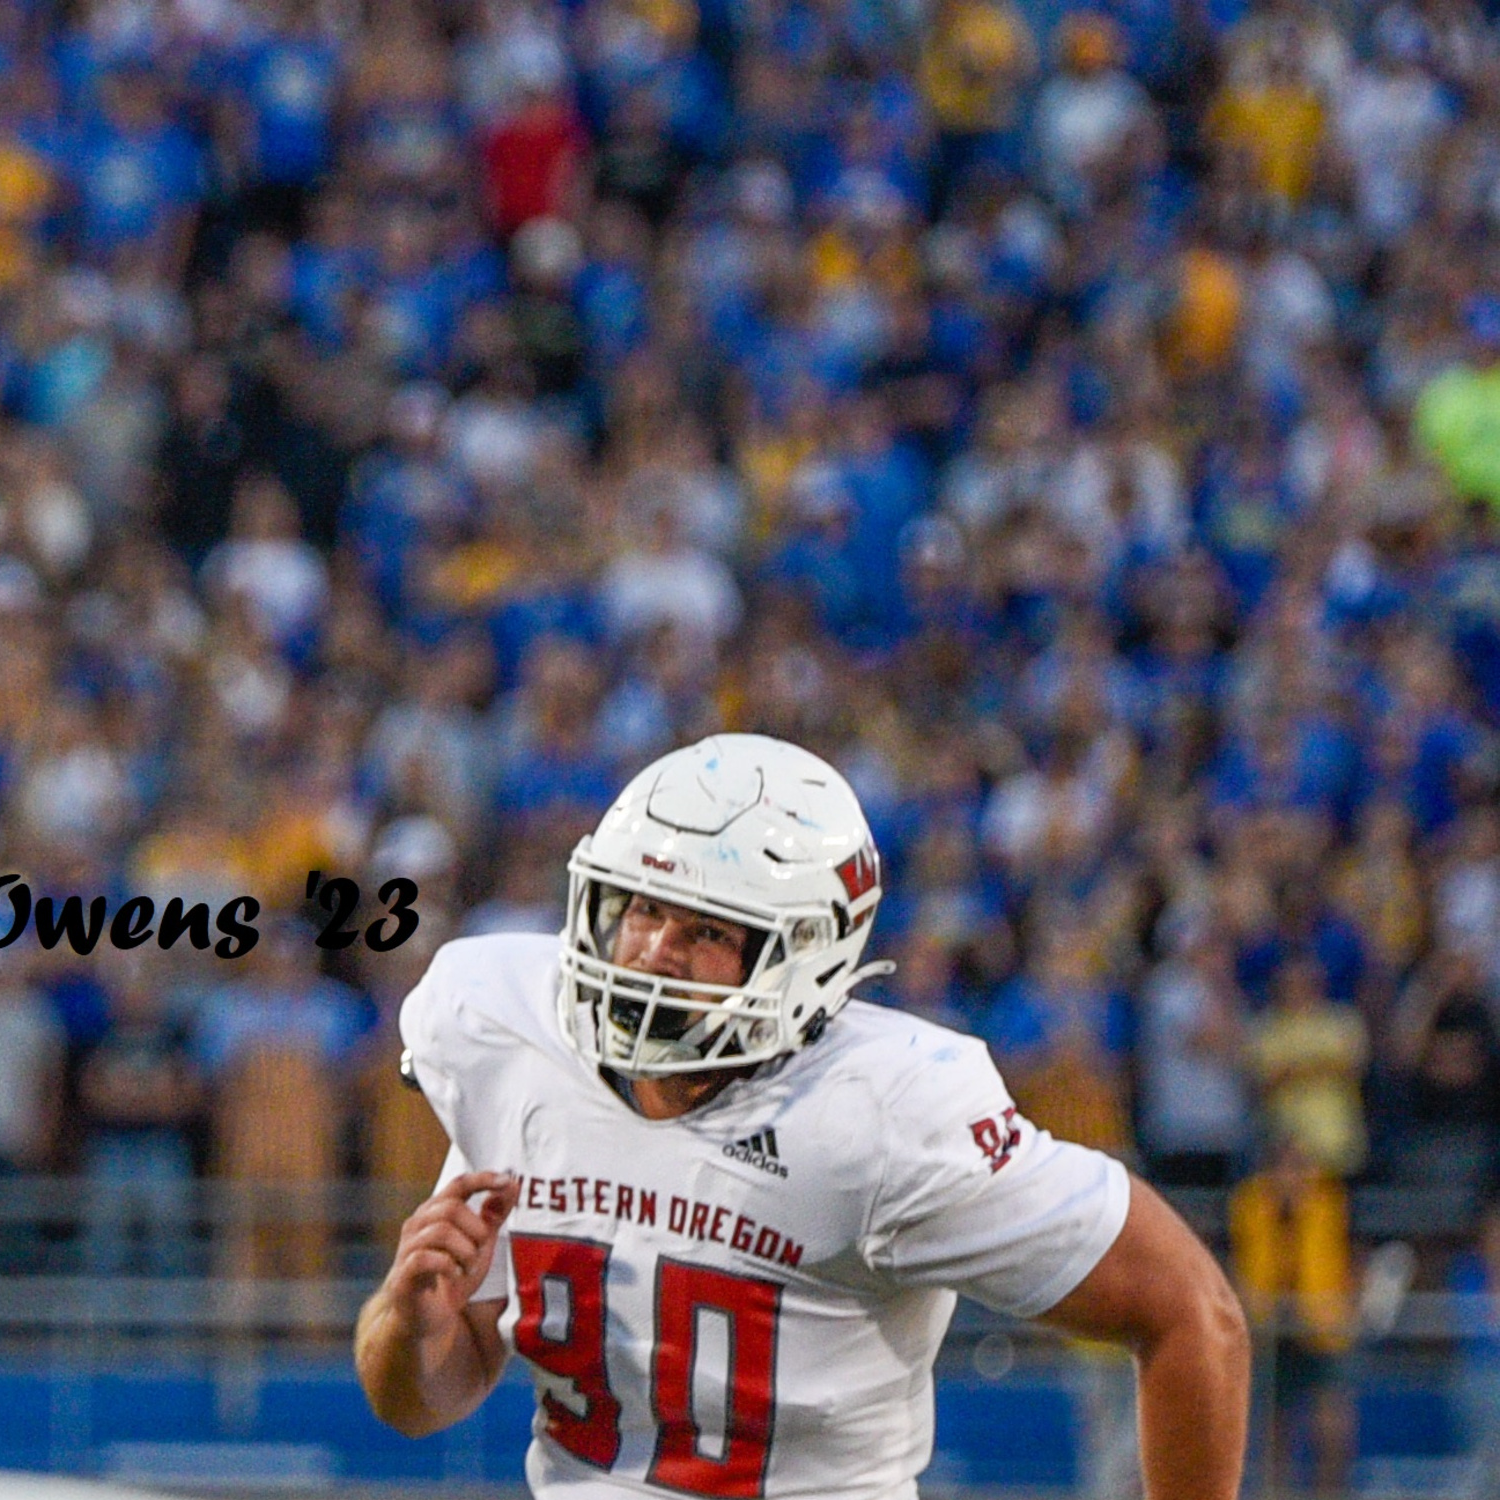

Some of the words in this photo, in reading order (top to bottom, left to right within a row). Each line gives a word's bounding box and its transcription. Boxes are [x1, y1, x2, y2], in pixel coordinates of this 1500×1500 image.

[722, 1143, 789, 1180] adidas
[668, 1196, 804, 1268] OREGON
[509, 1231, 784, 1500] 90
